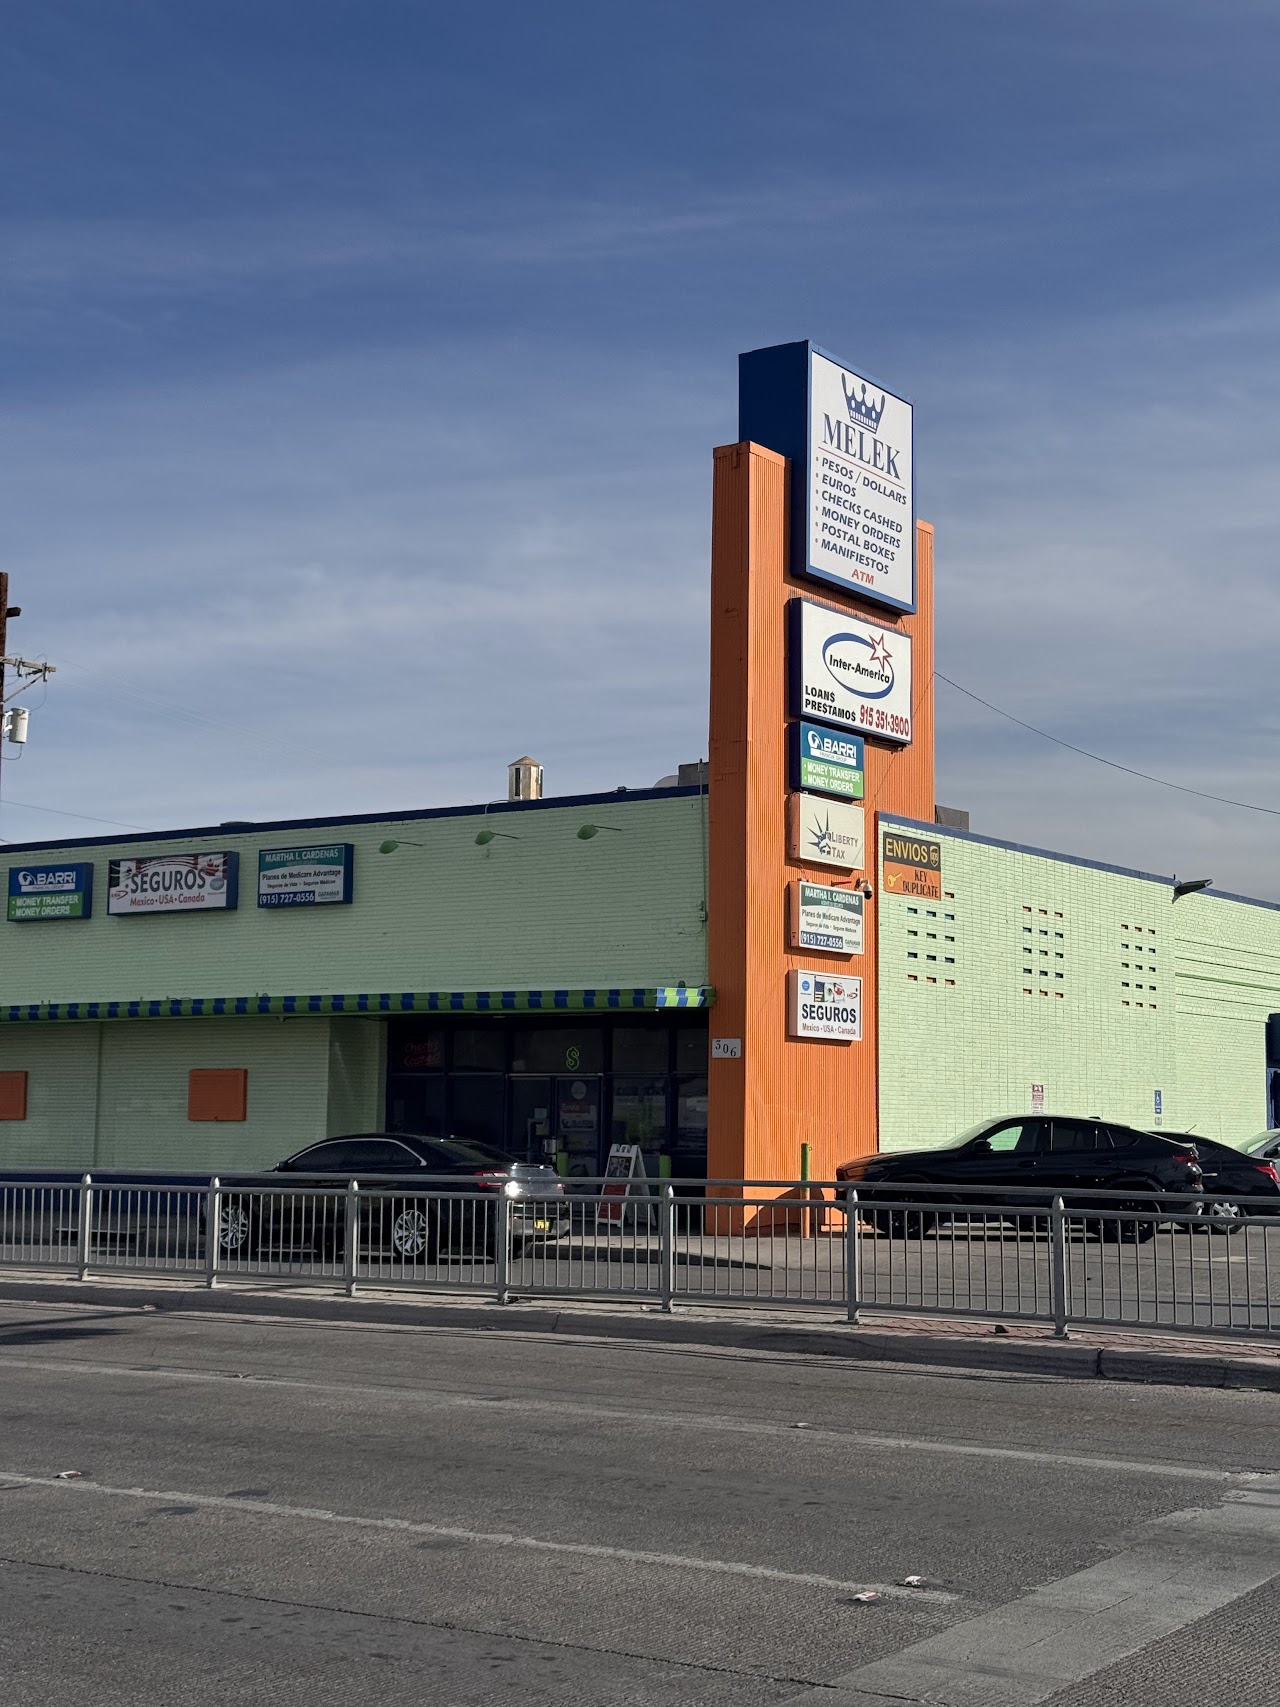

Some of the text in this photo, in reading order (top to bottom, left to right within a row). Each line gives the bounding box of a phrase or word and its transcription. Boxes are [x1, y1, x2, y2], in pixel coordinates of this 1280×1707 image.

[822, 412, 900, 480] MELEK
[822, 457, 853, 479] PESOS
[863, 477, 907, 505] DOLLARS
[822, 474, 856, 497] EUROS
[822, 490, 902, 533] CHECKS CASHED
[822, 506, 900, 549] MONEY ORDERS
[822, 522, 895, 561] POSTAL BOXES
[821, 539, 889, 575] MANIFIESTOS
[852, 569, 874, 585] ATM
[829, 655, 890, 683] Inter-America
[860, 704, 873, 727] 915
[875, 709, 909, 736] 351-3900
[824, 738, 856, 758] BARRI
[808, 762, 860, 782] MONEY TRANSFER
[808, 774, 853, 792] MONEY ORDERS
[832, 832, 858, 847] LIBERTY
[266, 853, 294, 862] MARTHA
[302, 849, 338, 860] CARDENAS
[832, 847, 845, 859] TAX
[886, 838, 928, 863] ENVIOS
[37, 871, 76, 884] BARRI
[130, 869, 206, 894] SEGUROS
[915, 870, 928, 882] KEY
[158, 894, 174, 904] USA
[178, 893, 205, 903] Canada
[260, 893, 314, 904] (915) 727-0556
[805, 887, 827, 900] MARTHA
[833, 892, 859, 905] CARDENAS
[903, 881, 938, 898] DUPLICATE
[16, 895, 78, 906] MONEY TRANSFER
[16, 906, 70, 916] MONEY ORDERS
[802, 909, 815, 918] Planes
[822, 913, 839, 921] Medicare
[801, 932, 842, 948] (915) 727-0556
[802, 1004, 856, 1023] SEGUROS
[823, 1025, 834, 1033] USA
[838, 1026, 856, 1034] Canada
[715, 1039, 737, 1057] 306
